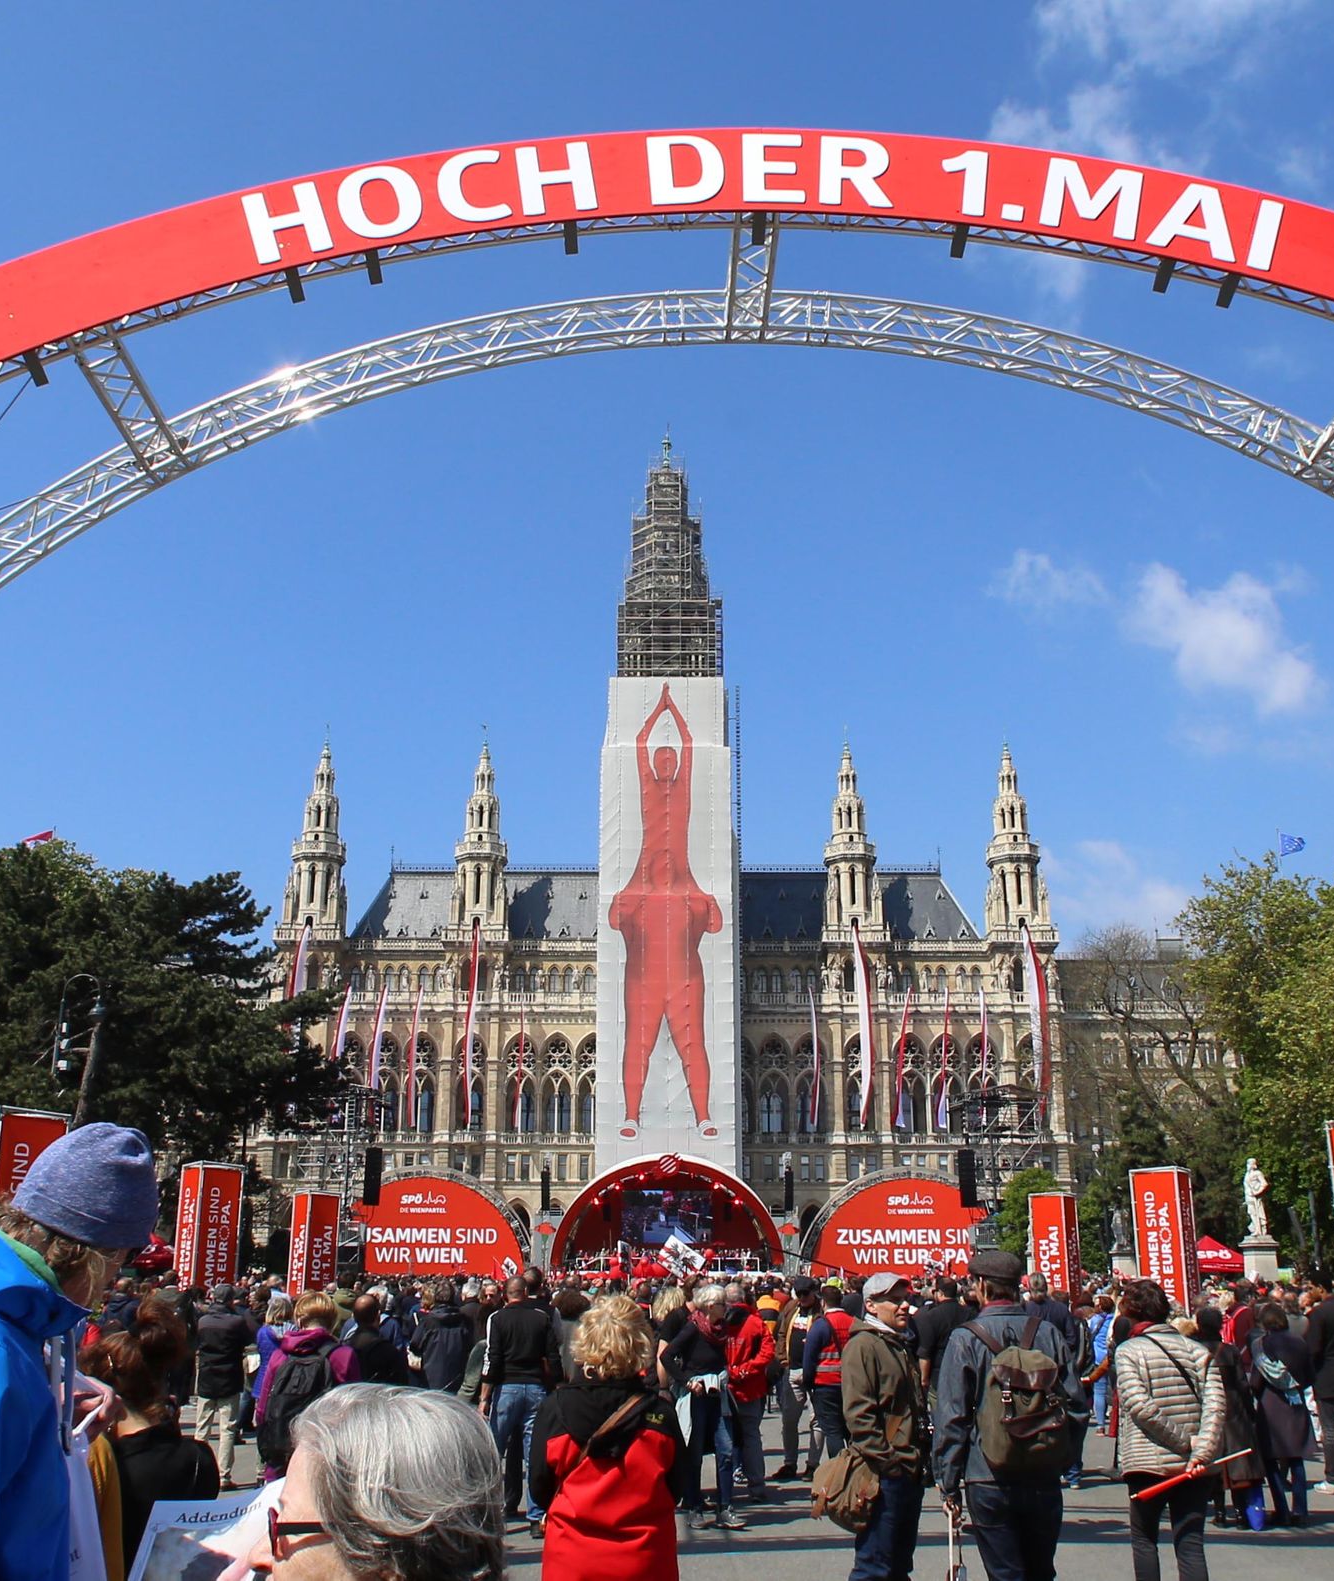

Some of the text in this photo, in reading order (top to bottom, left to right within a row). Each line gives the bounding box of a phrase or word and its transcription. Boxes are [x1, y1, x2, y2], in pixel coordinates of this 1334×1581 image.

[240, 133, 1285, 272] HOCH DER 1.MAI
[208, 1187, 221, 1223] SIND
[400, 1193, 424, 1205] SPÖ
[887, 1194, 910, 1206] SPÖ
[1143, 1191, 1157, 1228] SIND
[323, 1225, 333, 1255] MAI
[455, 1228, 498, 1244] SIND
[836, 1228, 970, 1245] ZUSAMMEN SIN
[1048, 1226, 1060, 1255] MAI
[291, 1237, 300, 1281] HOCH
[311, 1237, 322, 1281] HOCH
[375, 1247, 468, 1264] WIR WIEN.
[853, 1248, 890, 1265] WIR
[175, 1501, 263, 1524] Addendum
